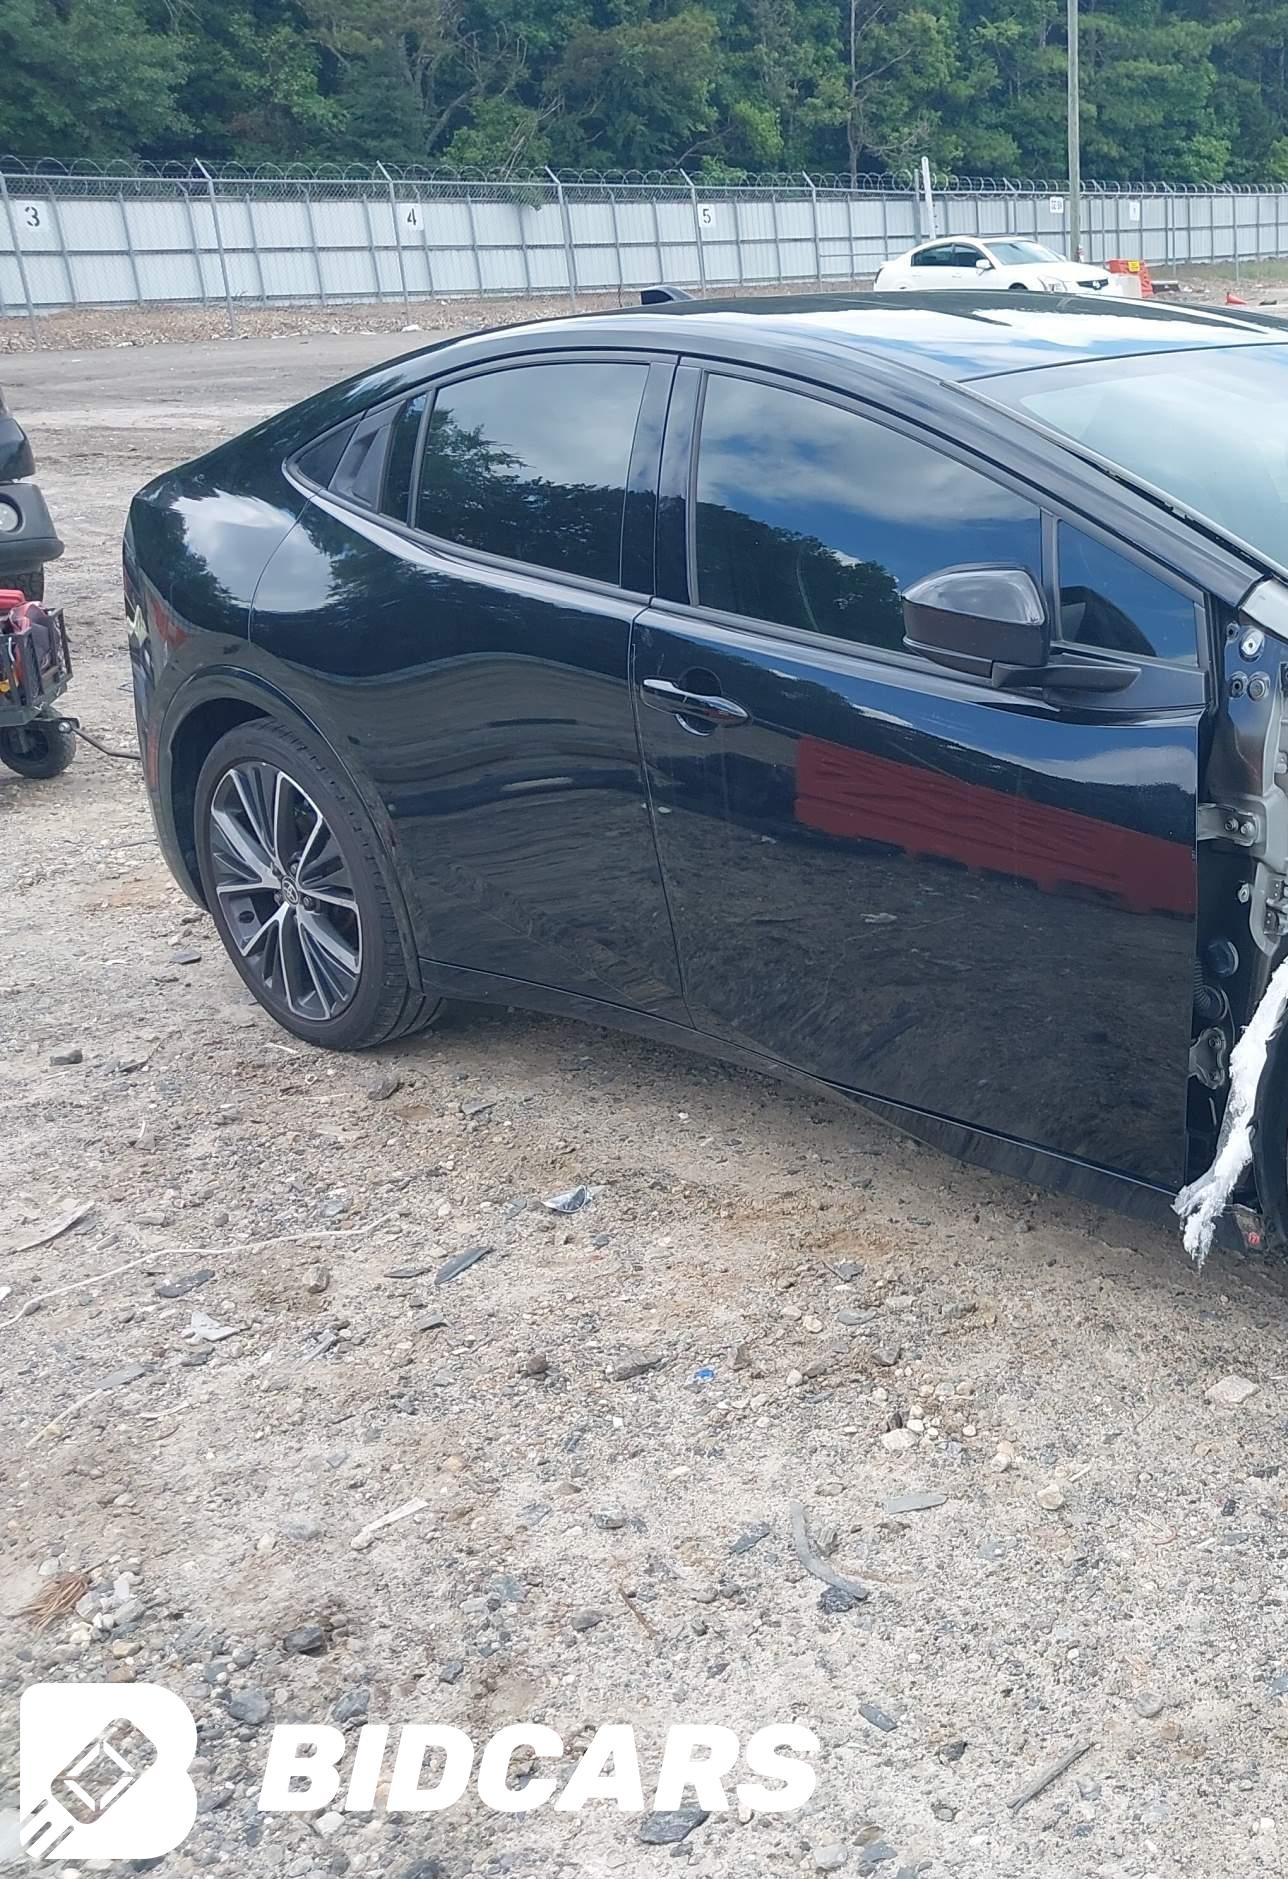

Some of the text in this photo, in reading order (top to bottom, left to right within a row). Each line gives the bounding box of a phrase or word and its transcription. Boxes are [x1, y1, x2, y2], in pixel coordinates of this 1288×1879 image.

[25, 206, 40, 227] 3
[407, 207, 417, 226] 4
[702, 208, 712, 224] 5
